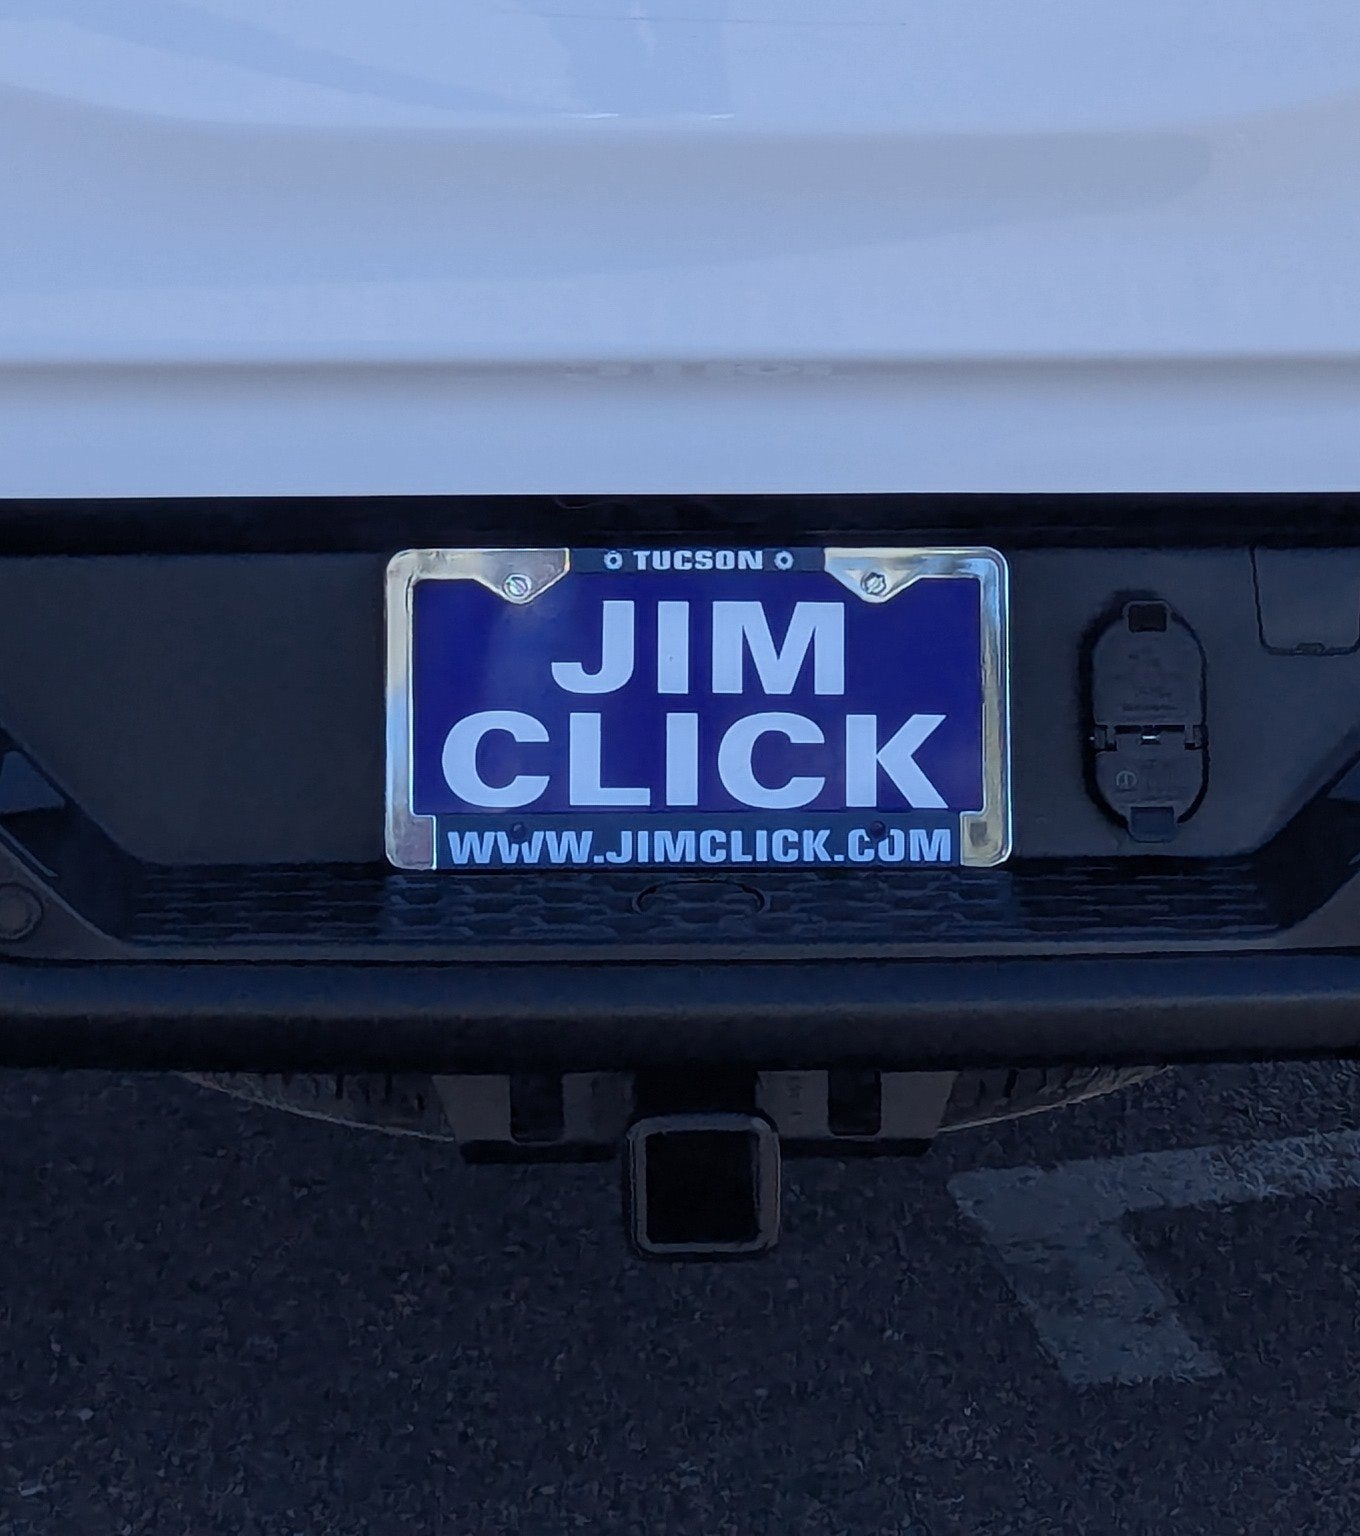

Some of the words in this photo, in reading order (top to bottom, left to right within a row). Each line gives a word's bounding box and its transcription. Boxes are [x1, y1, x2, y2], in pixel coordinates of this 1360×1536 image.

[633, 550, 764, 571] TUCSON
[551, 600, 845, 695] JIM
[441, 710, 949, 809] CLICK
[447, 829, 952, 865] WWW.JIMCLICK.COM
